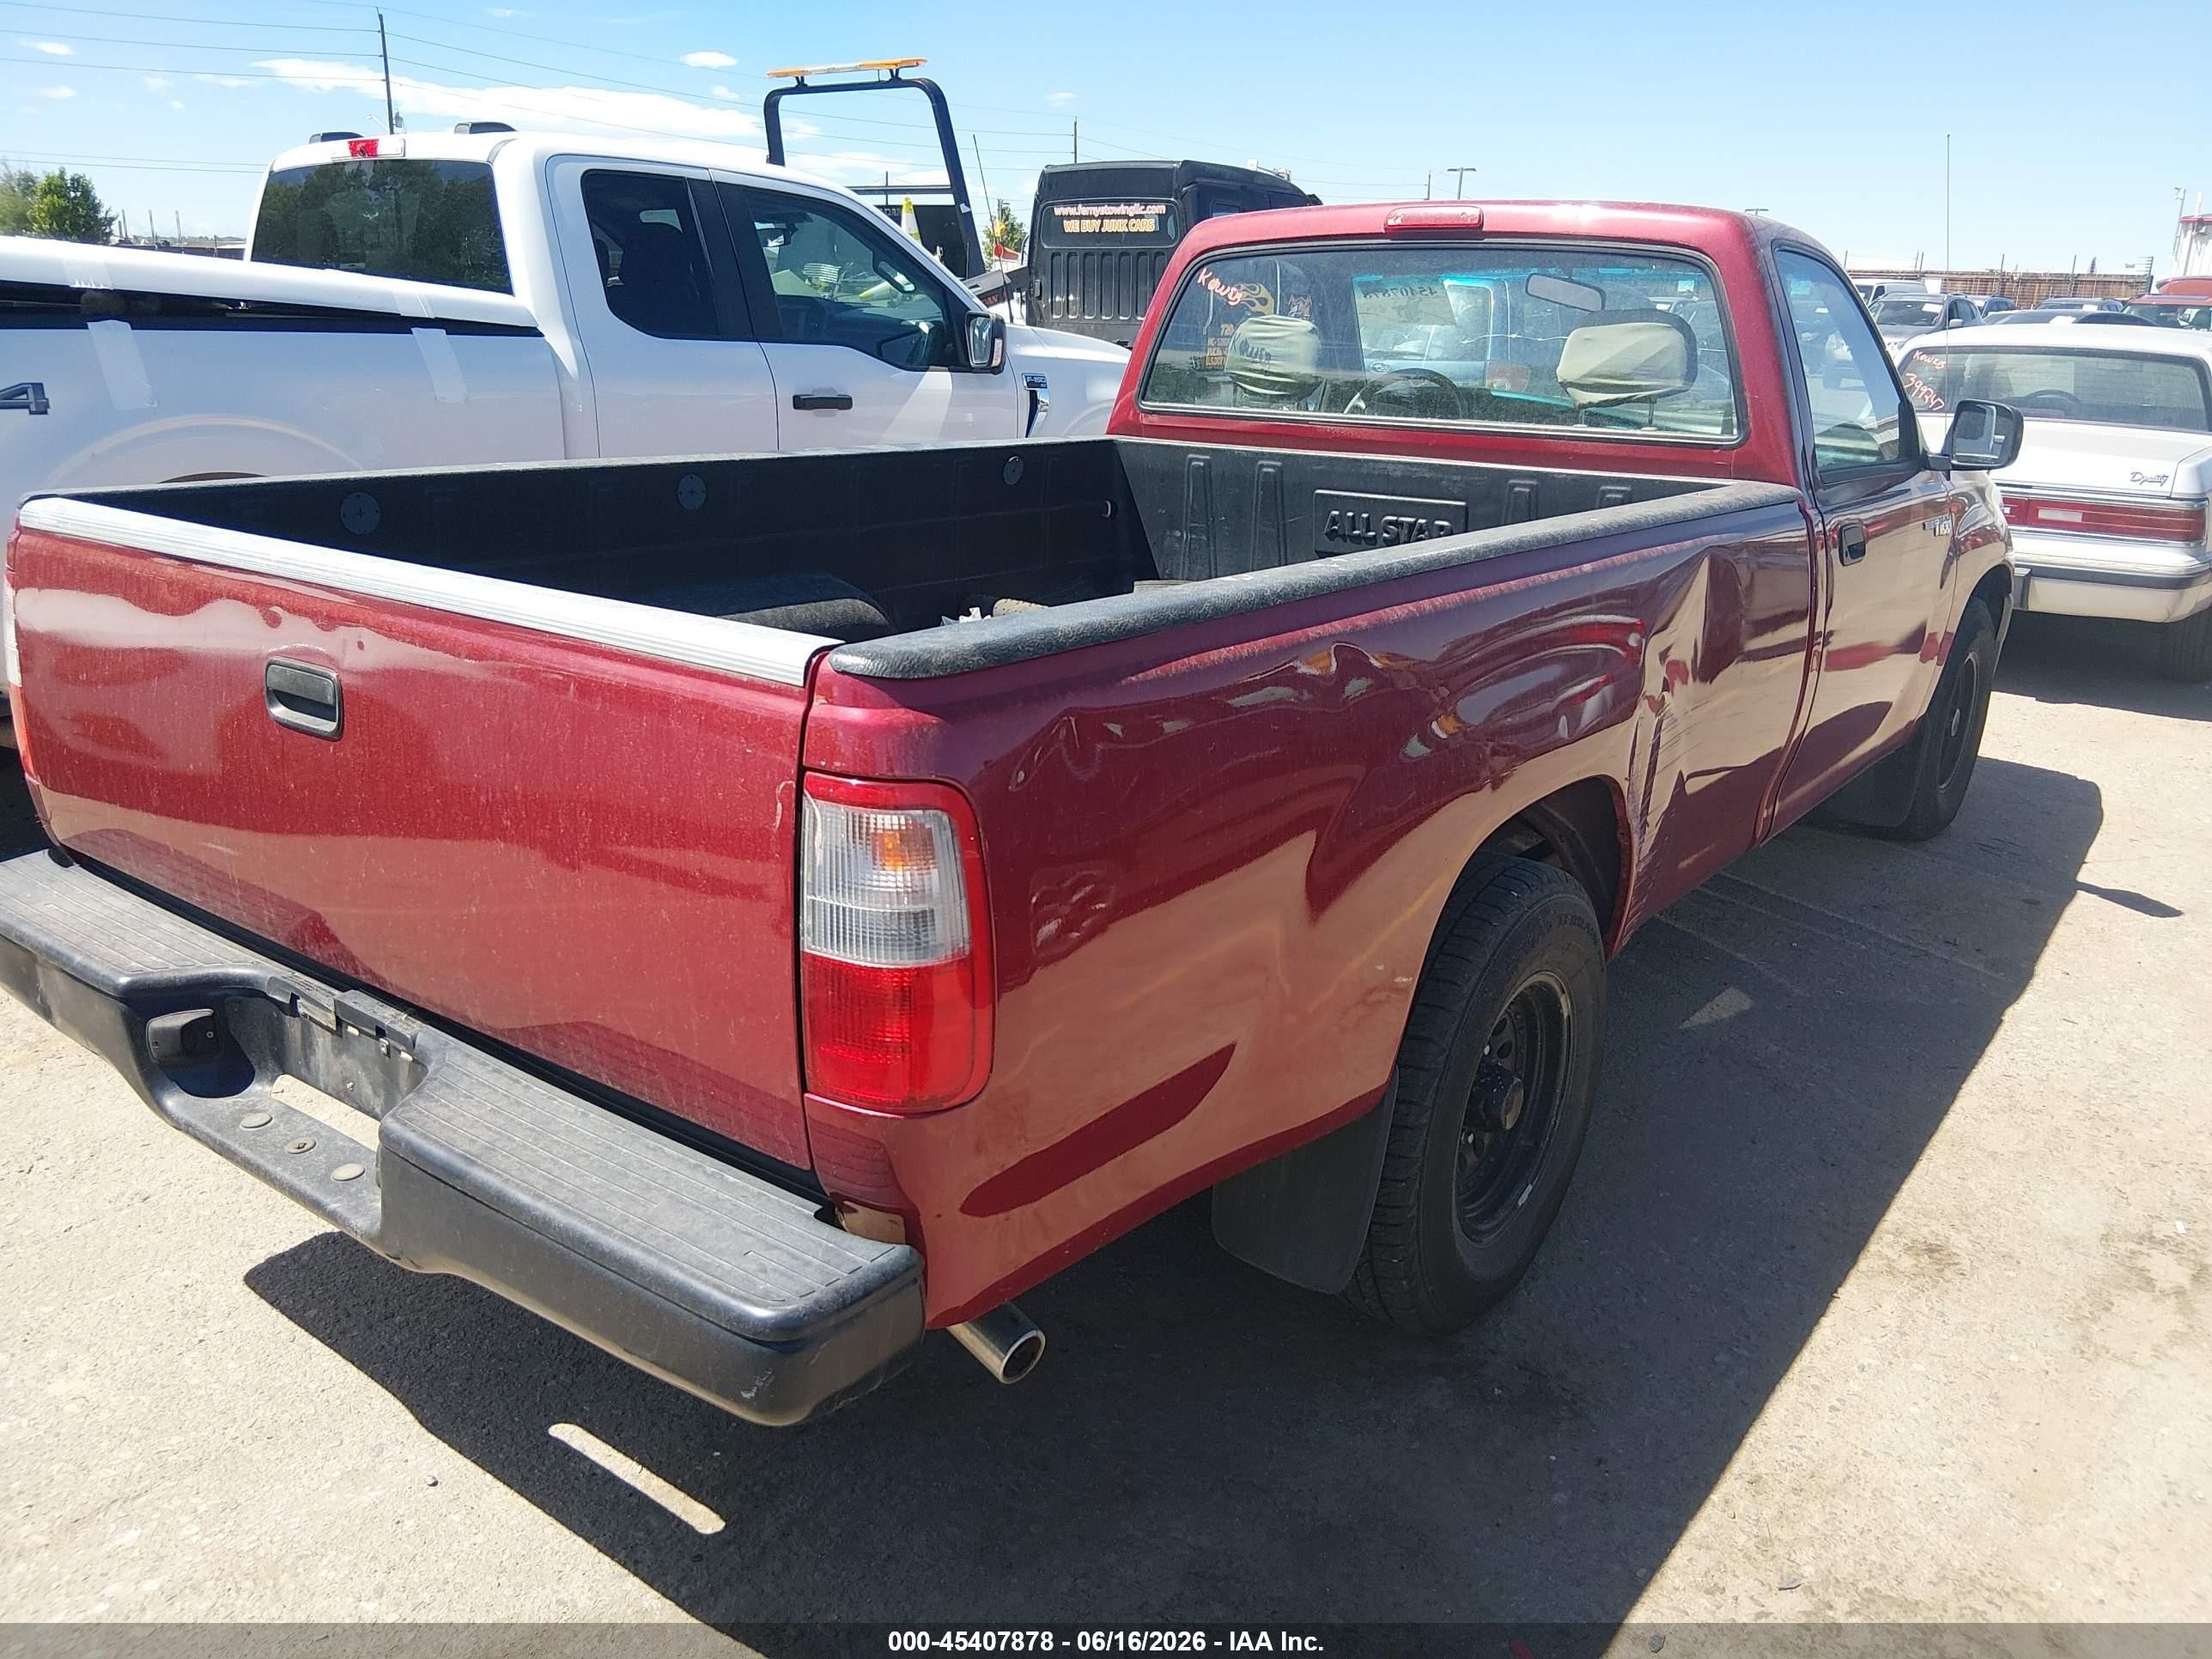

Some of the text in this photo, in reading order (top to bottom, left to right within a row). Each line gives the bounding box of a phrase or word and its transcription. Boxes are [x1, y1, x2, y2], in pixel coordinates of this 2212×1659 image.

[1063, 218, 1155, 232] WE BUY JUNK CARS
[1324, 510, 1377, 544] ALL
